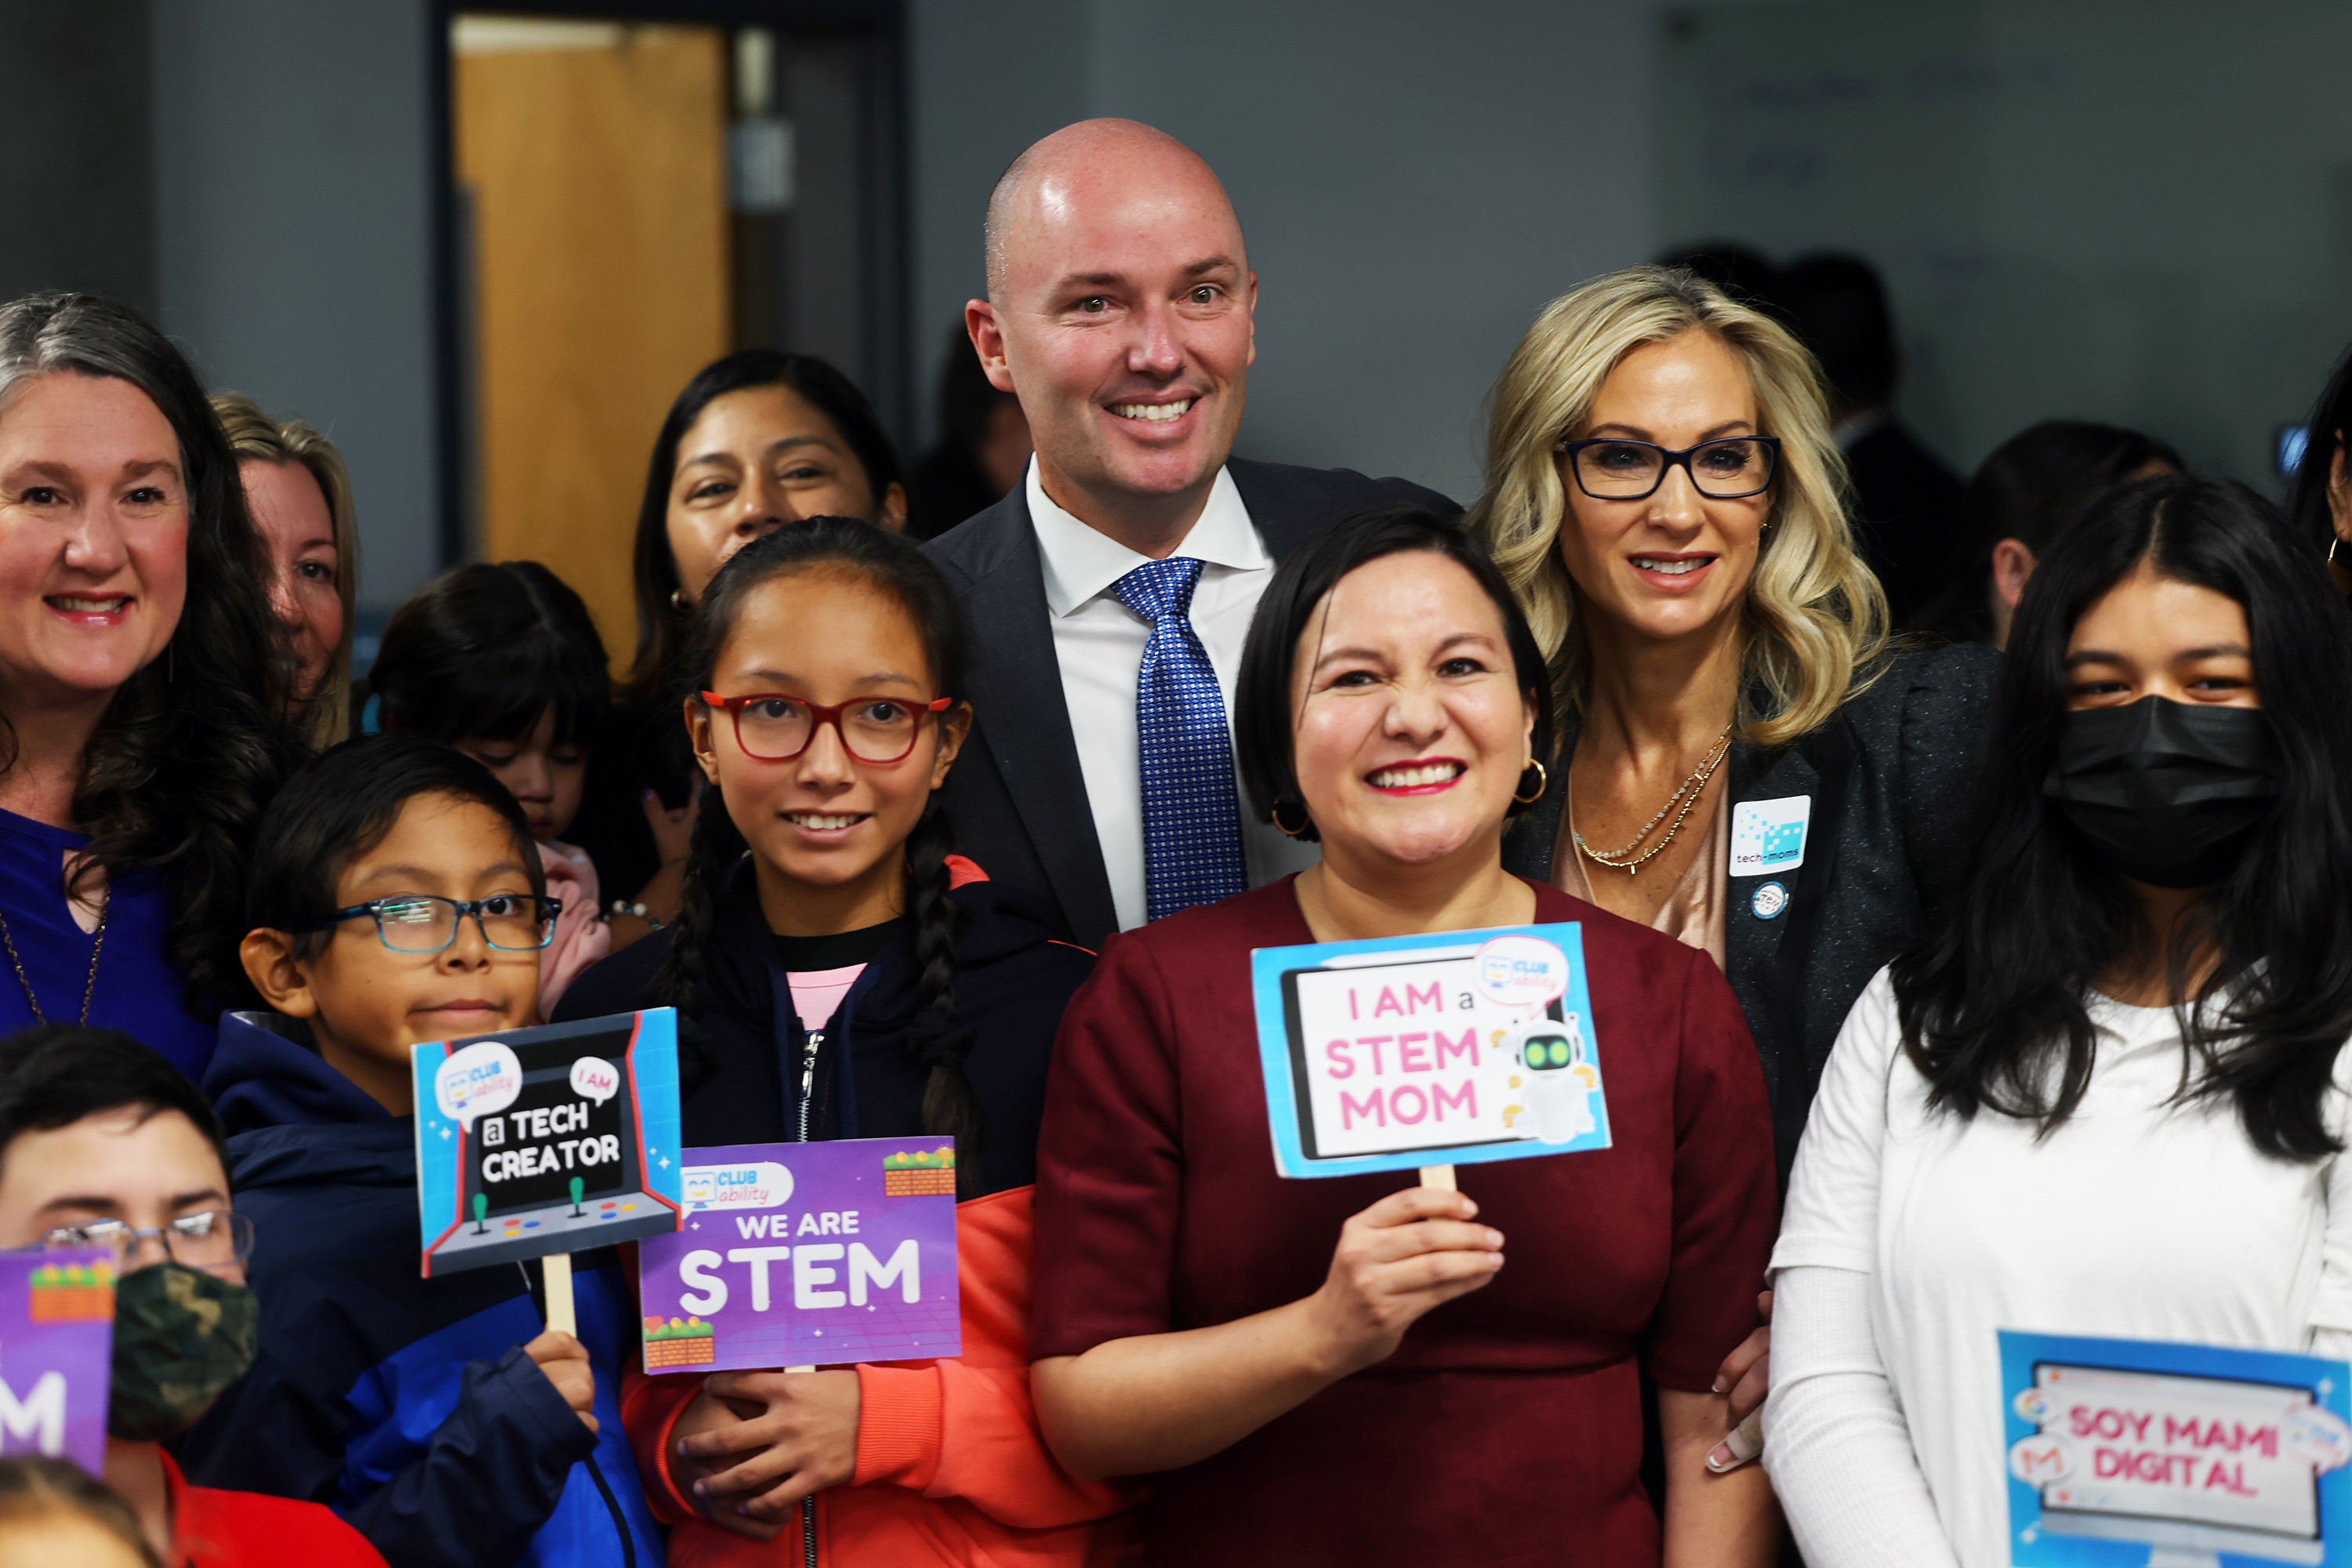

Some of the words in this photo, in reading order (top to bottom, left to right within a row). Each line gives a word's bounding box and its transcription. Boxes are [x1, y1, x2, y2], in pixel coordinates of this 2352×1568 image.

[1737, 848, 1799, 863] tech-moms
[1513, 960, 1548, 974] CLUB
[1348, 987, 1358, 1020] I
[1374, 981, 1443, 1018] AM
[1458, 992, 1475, 1010] a
[470, 1061, 501, 1081] CLUB
[1325, 1027, 1481, 1080] STEM
[579, 1069, 585, 1083] I
[586, 1073, 612, 1091] AM
[510, 1102, 589, 1140] TECH
[1339, 1079, 1478, 1131] MOM
[481, 1134, 620, 1183] CREATOR
[717, 1170, 758, 1185] CLUB
[719, 1185, 770, 1205] ability
[735, 1214, 789, 1240] WE
[797, 1210, 860, 1236] ARE
[679, 1239, 920, 1316] STEM
[2069, 1403, 2153, 1443] SOY
[2164, 1413, 2280, 1459] MAMI
[2093, 1446, 2259, 1498] DIGITAL
